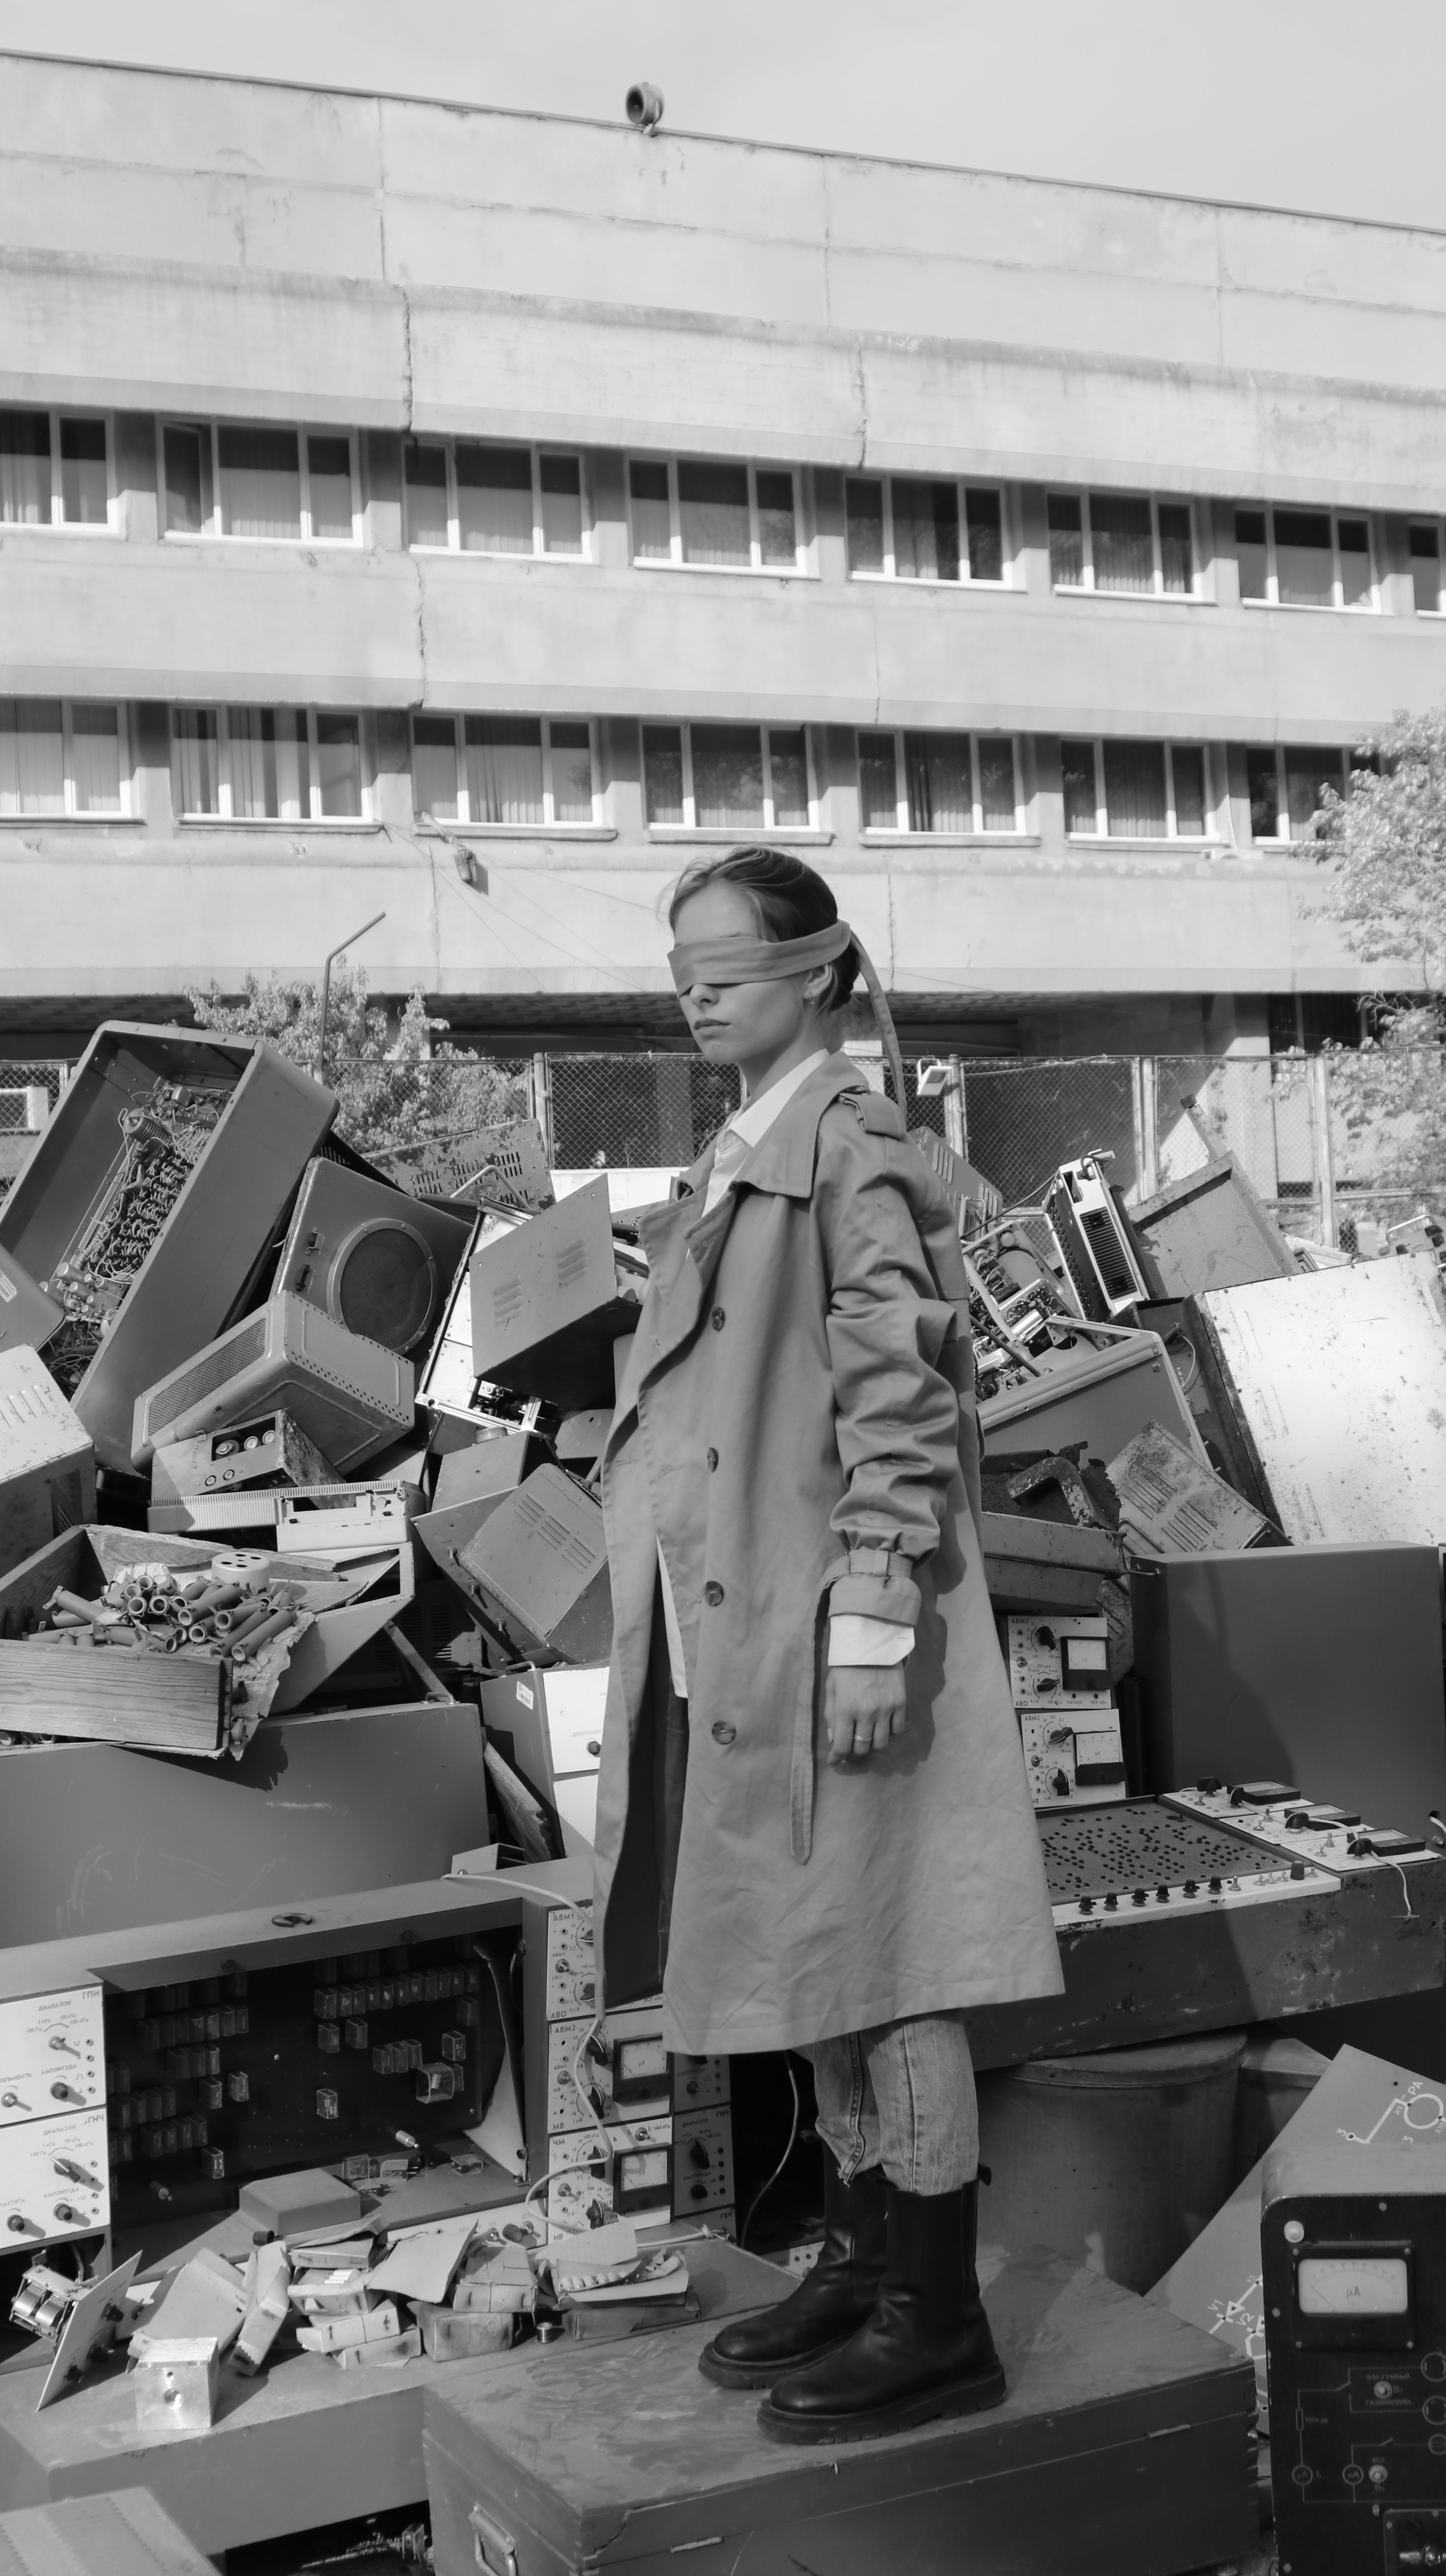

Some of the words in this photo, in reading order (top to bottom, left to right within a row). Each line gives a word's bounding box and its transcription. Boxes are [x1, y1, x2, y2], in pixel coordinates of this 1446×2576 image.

[572, 1729, 603, 1738] ДЛИТЕЛЬНОС
[82, 1990, 100, 1999] ГПИ
[38, 2000, 71, 2012] ДИАПАЗОН
[551, 2011, 567, 2019] АВО
[555, 2025, 575, 2033] АВМ2
[40, 2064, 77, 2075] АМПЛИТУДА
[1407, 2081, 1423, 2095] PA
[88, 2114, 104, 2123] ГНЧ
[682, 2118, 708, 2127] ДИАПАЗОН
[43, 2125, 76, 2136] ДИАПАЗОН
[43, 2187, 79, 2198] АМПЛИТУДА
[721, 2211, 732, 2220] ГВЧ
[1347, 2286, 1360, 2300] μA
[1207, 2300, 1223, 2310] V1
[1236, 2313, 1254, 2325] V2
